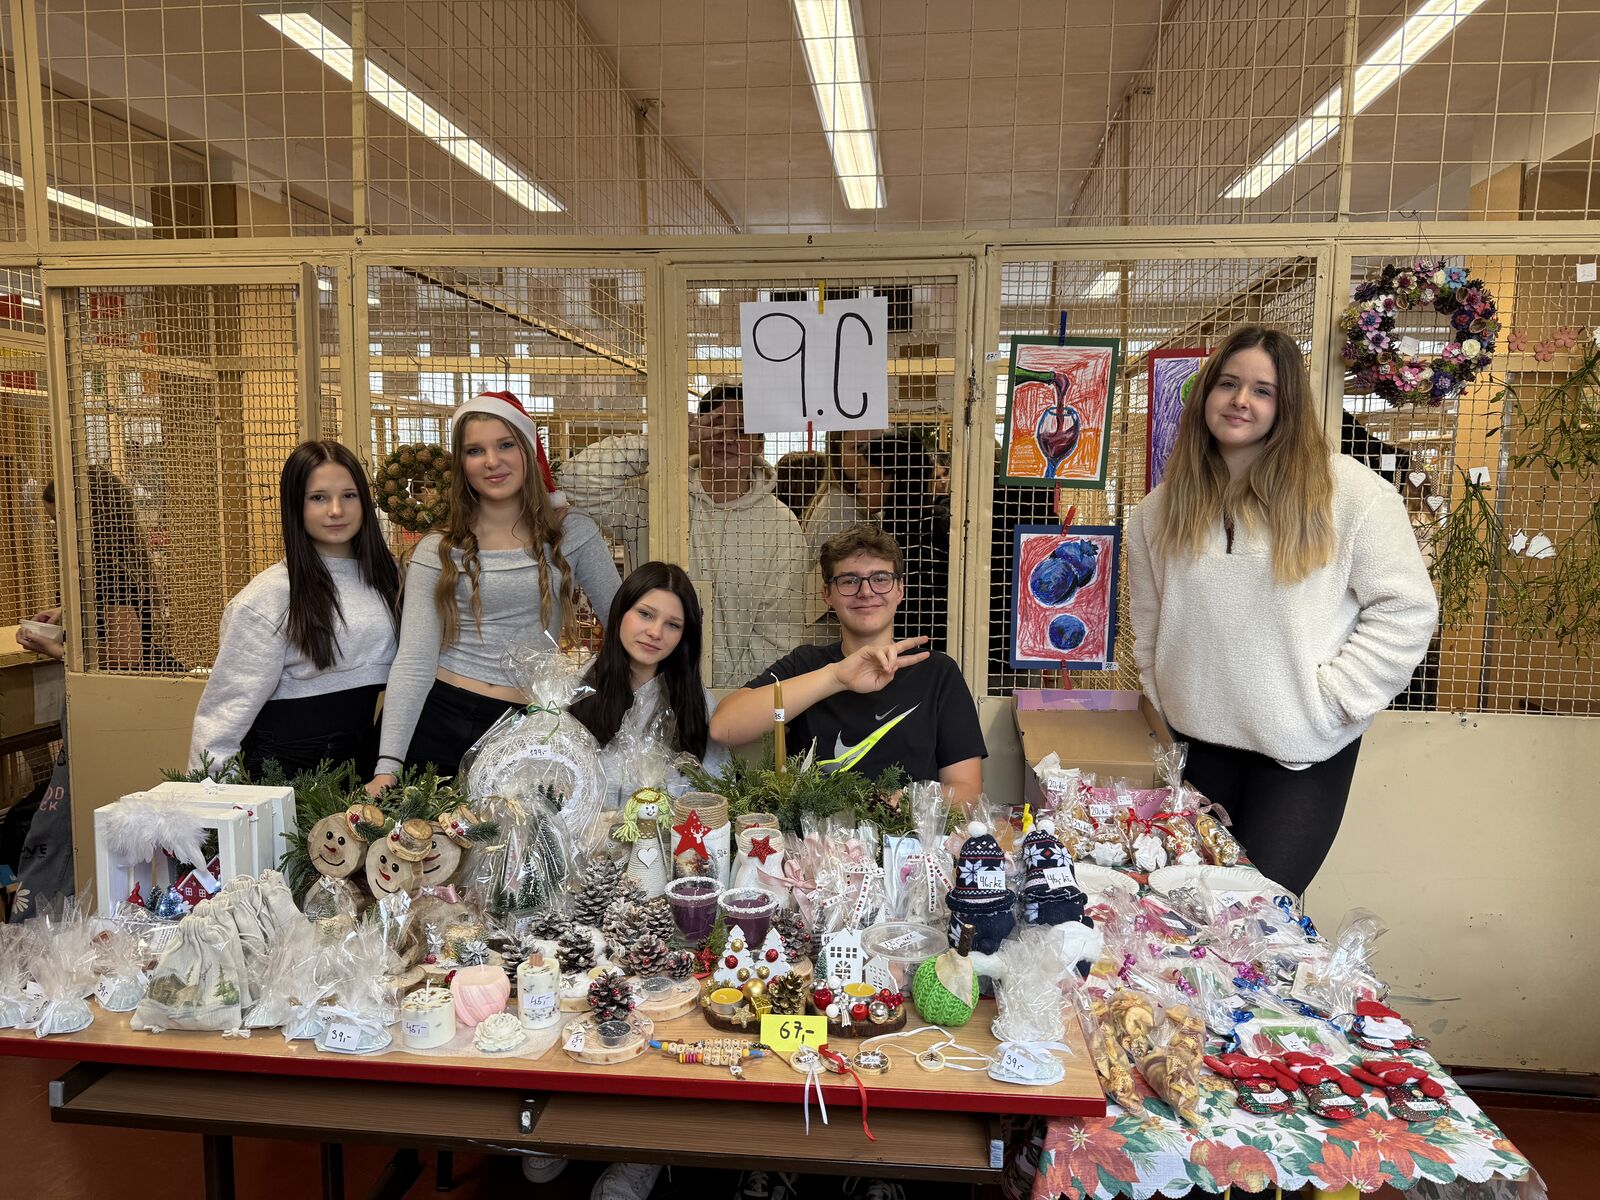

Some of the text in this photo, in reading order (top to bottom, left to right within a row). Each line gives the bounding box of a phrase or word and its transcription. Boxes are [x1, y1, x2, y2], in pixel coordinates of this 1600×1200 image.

[807, 234, 813, 244] 8
[752, 312, 873, 419] 9.C
[405, 1021, 428, 1035] 45,-
[779, 1020, 815, 1044] 67,-
[331, 1029, 352, 1043] 39,-
